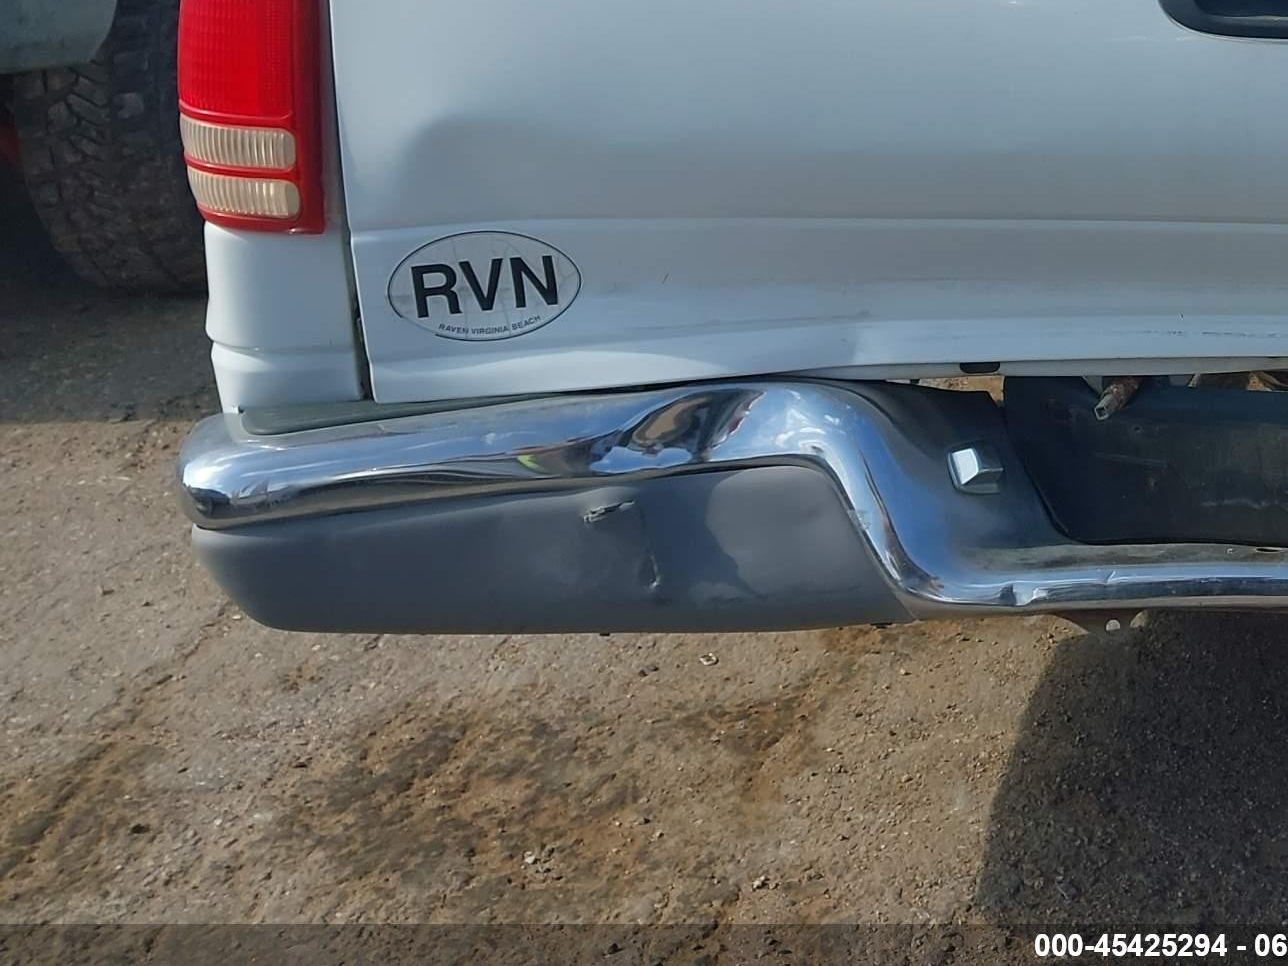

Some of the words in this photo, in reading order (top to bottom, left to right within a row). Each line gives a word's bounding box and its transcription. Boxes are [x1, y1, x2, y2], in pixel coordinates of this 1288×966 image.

[411, 255, 559, 318] RVN
[438, 322, 470, 335] RAVEN
[471, 325, 510, 336] VIRGINIA
[512, 315, 541, 331] BEACH
